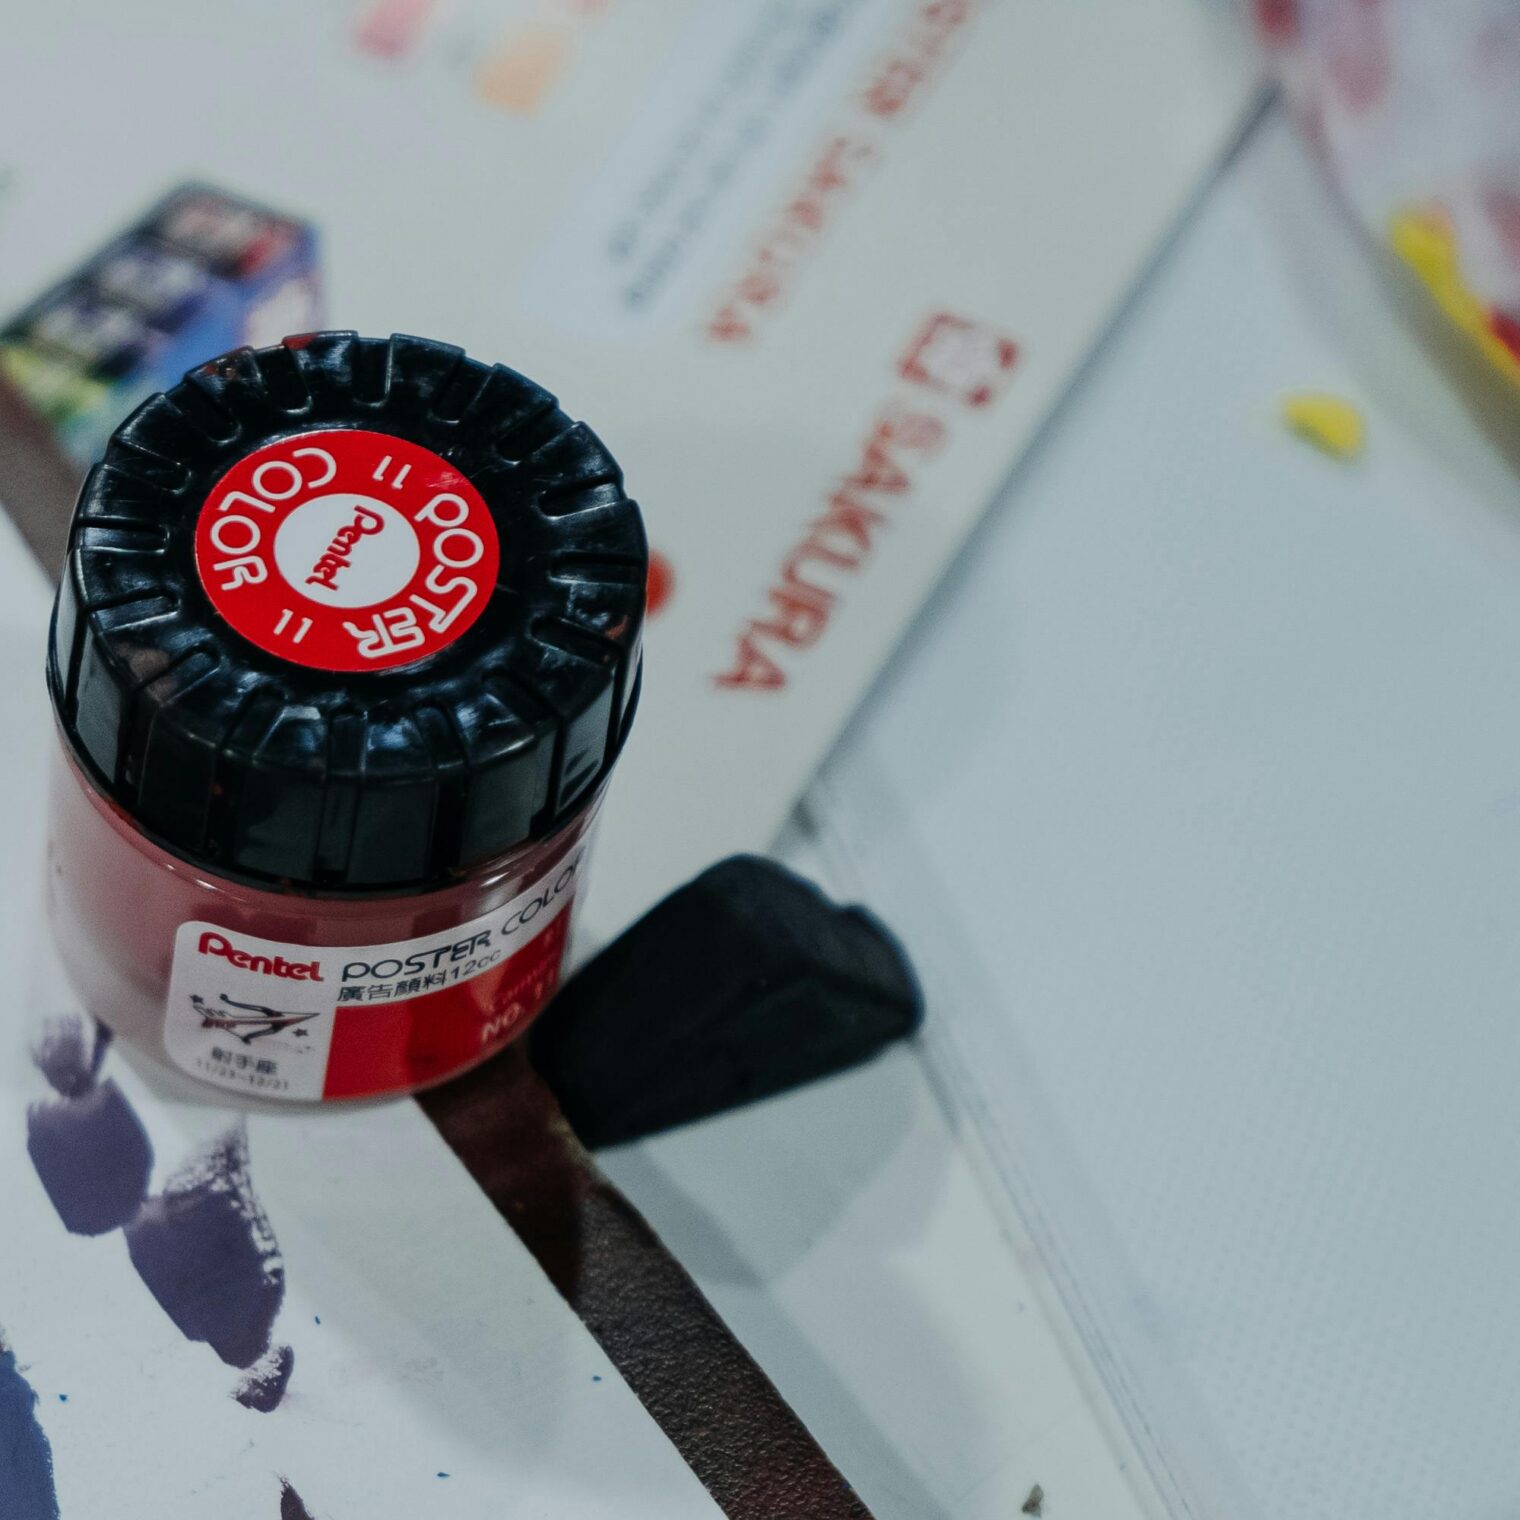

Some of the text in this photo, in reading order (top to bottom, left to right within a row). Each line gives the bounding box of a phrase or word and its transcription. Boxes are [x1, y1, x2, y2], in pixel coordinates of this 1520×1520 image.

[372, 455, 412, 489] 11
[211, 447, 484, 658] POSTER COLOR
[305, 504, 385, 591] Pentel
[711, 402, 947, 692] SAKURA
[273, 608, 313, 645] 11
[198, 932, 324, 982] Pentel
[342, 929, 492, 983] POSTER
